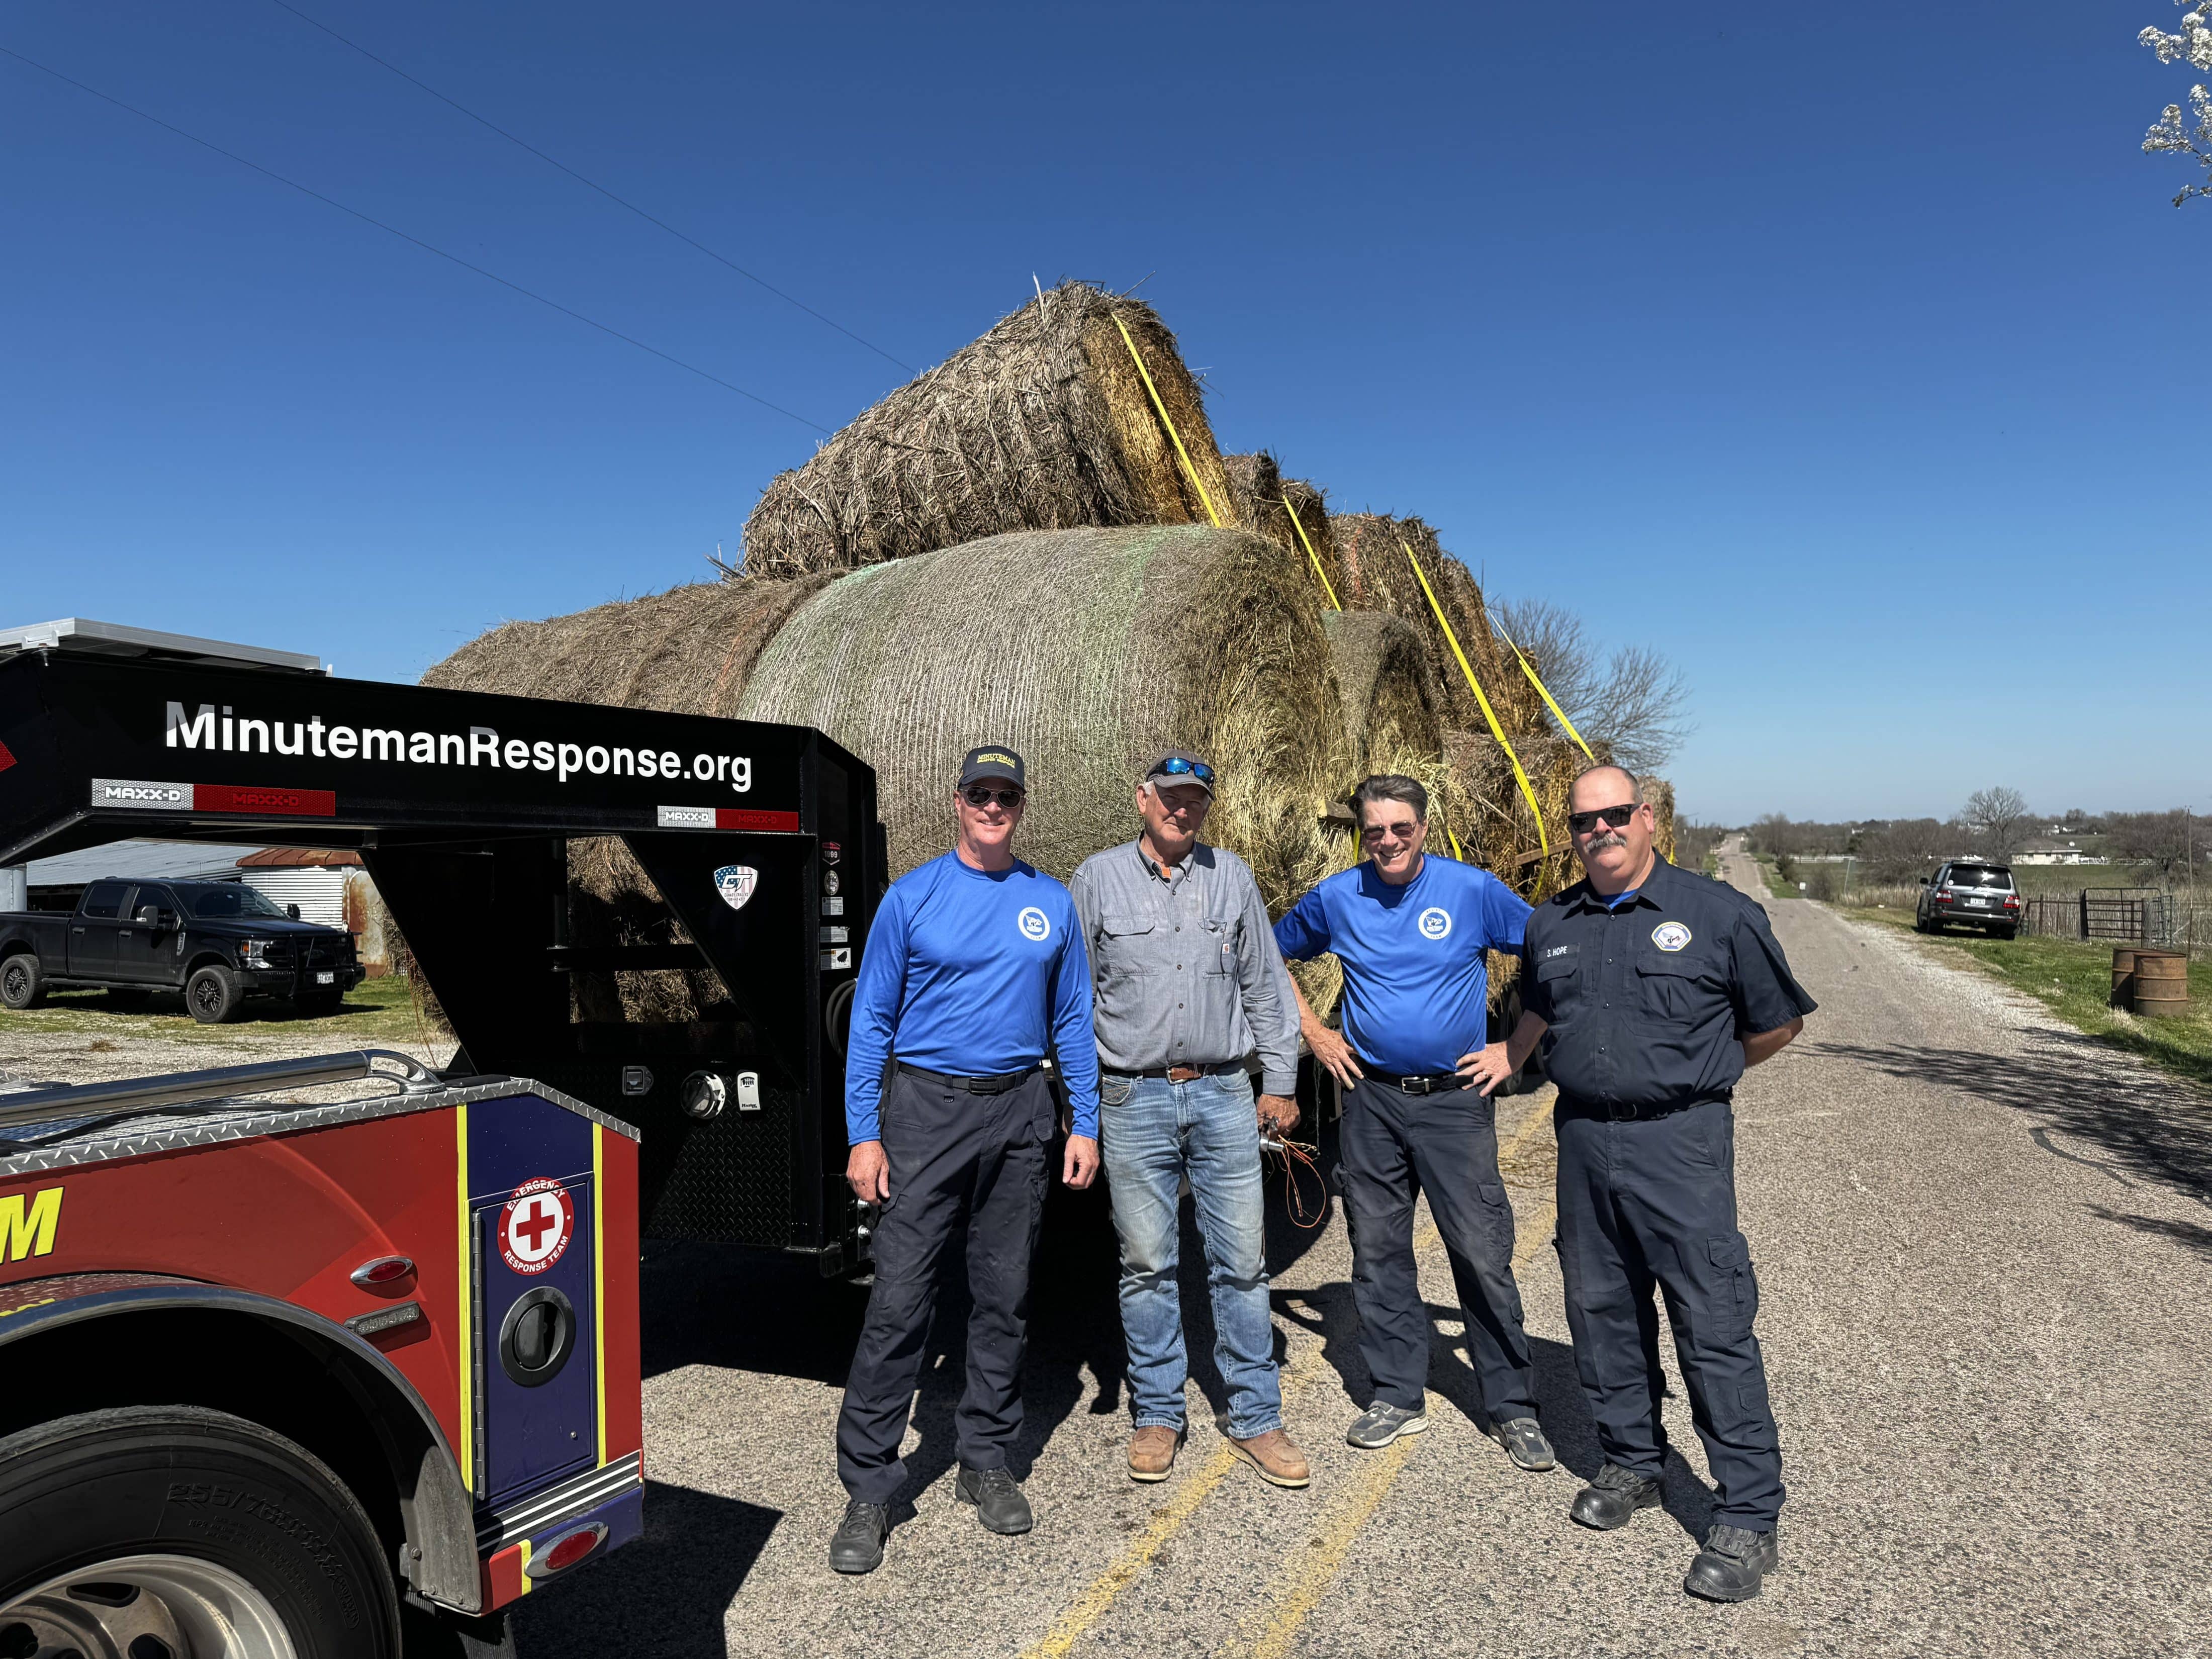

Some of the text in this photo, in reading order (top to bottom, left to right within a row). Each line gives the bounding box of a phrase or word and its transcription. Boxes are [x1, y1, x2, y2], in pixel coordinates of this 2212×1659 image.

[166, 701, 752, 792] MinutemanResponse.org
[977, 753, 1016, 766] MINUTEMAN
[105, 786, 181, 802] MAXX-D
[232, 793, 299, 807] MAXX-D
[665, 811, 709, 822] MAXX-D
[1552, 946, 1568, 957] HOPE
[506, 1179, 566, 1212] EMERGENCY
[504, 1235, 569, 1272] RESPONSE TEAM
